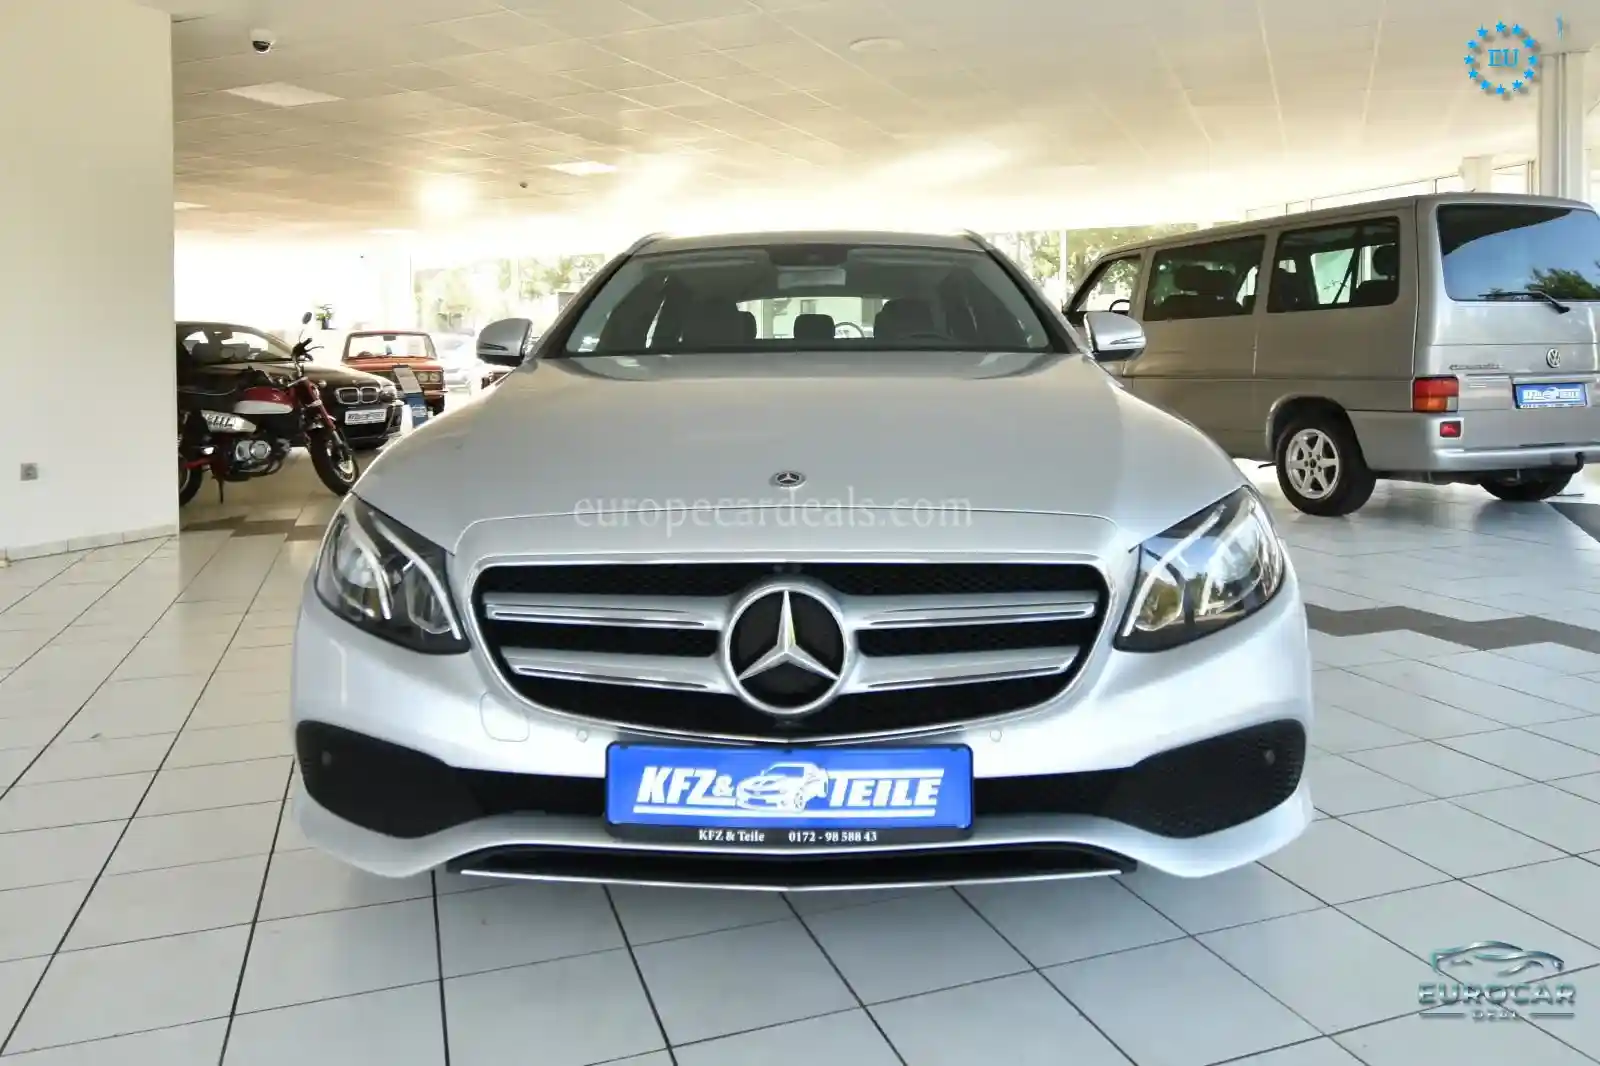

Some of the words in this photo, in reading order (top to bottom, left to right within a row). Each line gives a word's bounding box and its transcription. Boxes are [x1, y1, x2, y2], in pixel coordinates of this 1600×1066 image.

[828, 768, 944, 807] TEILE
[698, 830, 724, 841] KFZ
[726, 831, 735, 841] &
[737, 831, 765, 842] Teile
[788, 830, 816, 842] 0172
[824, 831, 839, 842] 98
[841, 831, 862, 842] 588
[863, 831, 877, 842] 43
